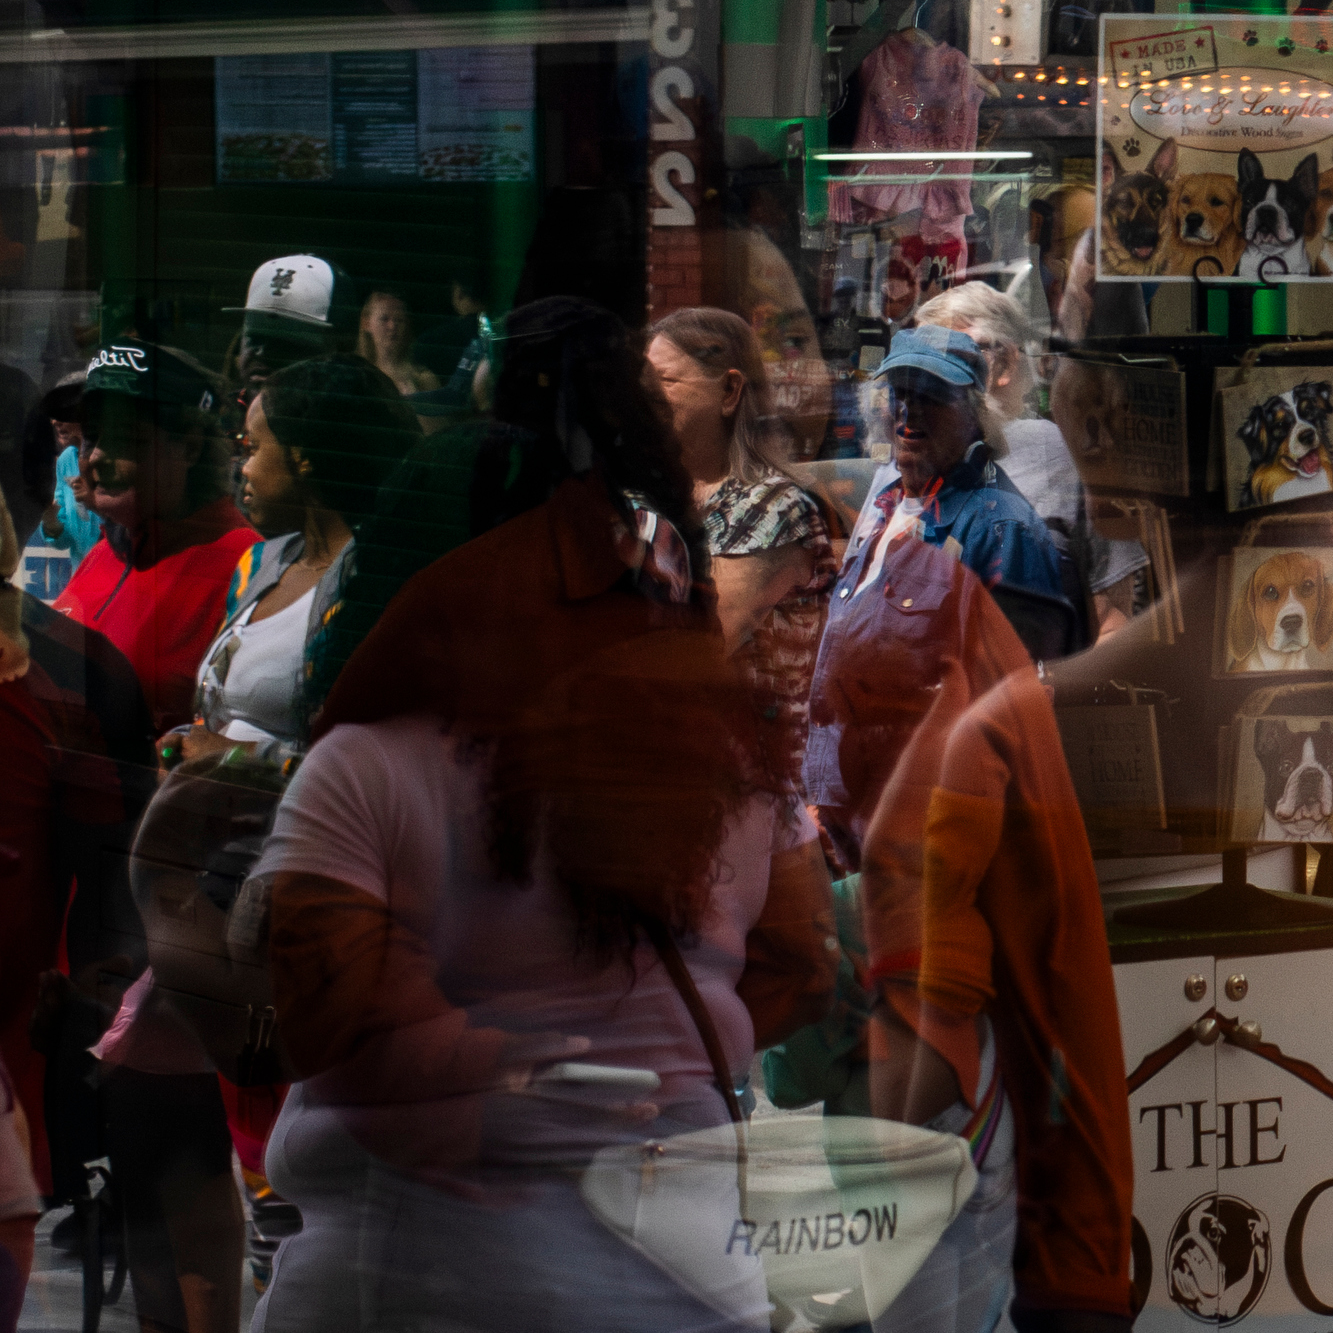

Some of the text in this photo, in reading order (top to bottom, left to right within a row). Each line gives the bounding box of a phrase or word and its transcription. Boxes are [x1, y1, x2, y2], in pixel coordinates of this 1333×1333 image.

[1137, 38, 1187, 60] MADE
[1163, 54, 1197, 72] USA
[1146, 88, 1200, 118] Love
[1204, 94, 1234, 126] &
[1181, 125, 1275, 138] Decorative Wood
[1138, 1095, 1288, 1174] THE
[723, 1201, 900, 1260] RAINBOW
